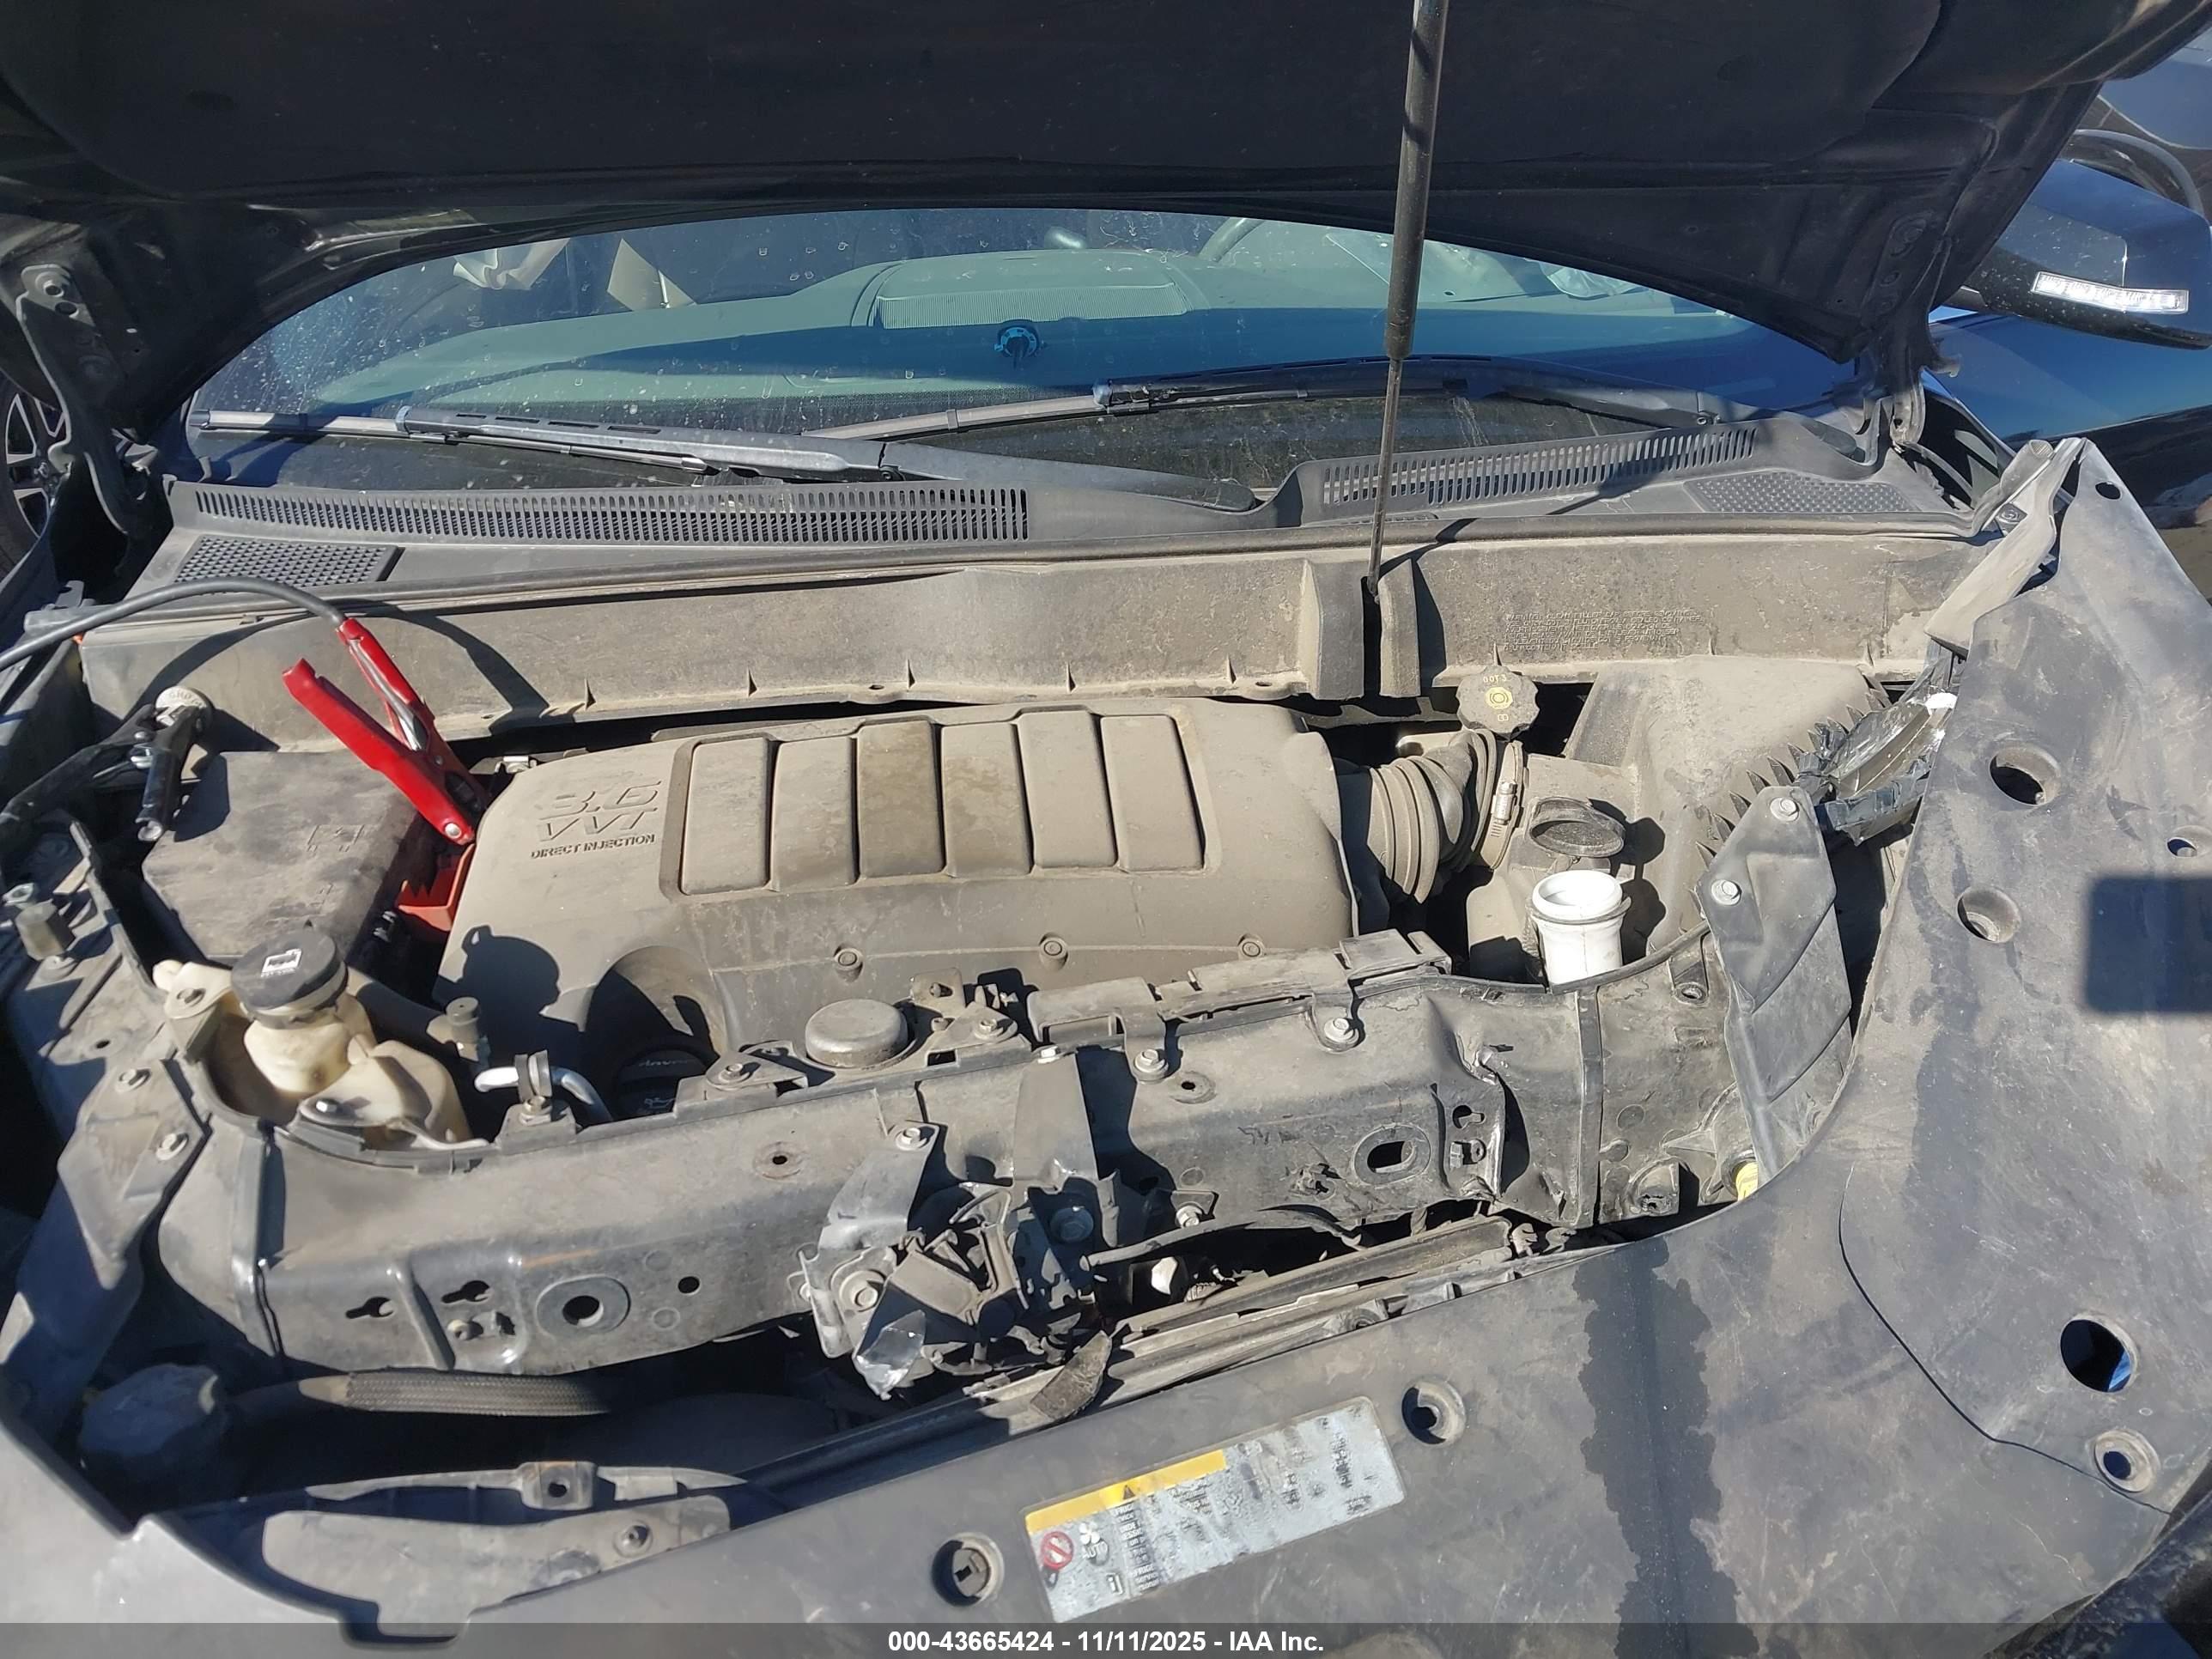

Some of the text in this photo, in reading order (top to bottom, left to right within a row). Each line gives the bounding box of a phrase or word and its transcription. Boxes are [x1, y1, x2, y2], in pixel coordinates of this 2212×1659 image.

[1483, 673, 1507, 684] DOT 3
[534, 781, 661, 821] 3.6
[536, 807, 658, 842] VVT
[531, 834, 655, 860] DIRECT INJECTION
